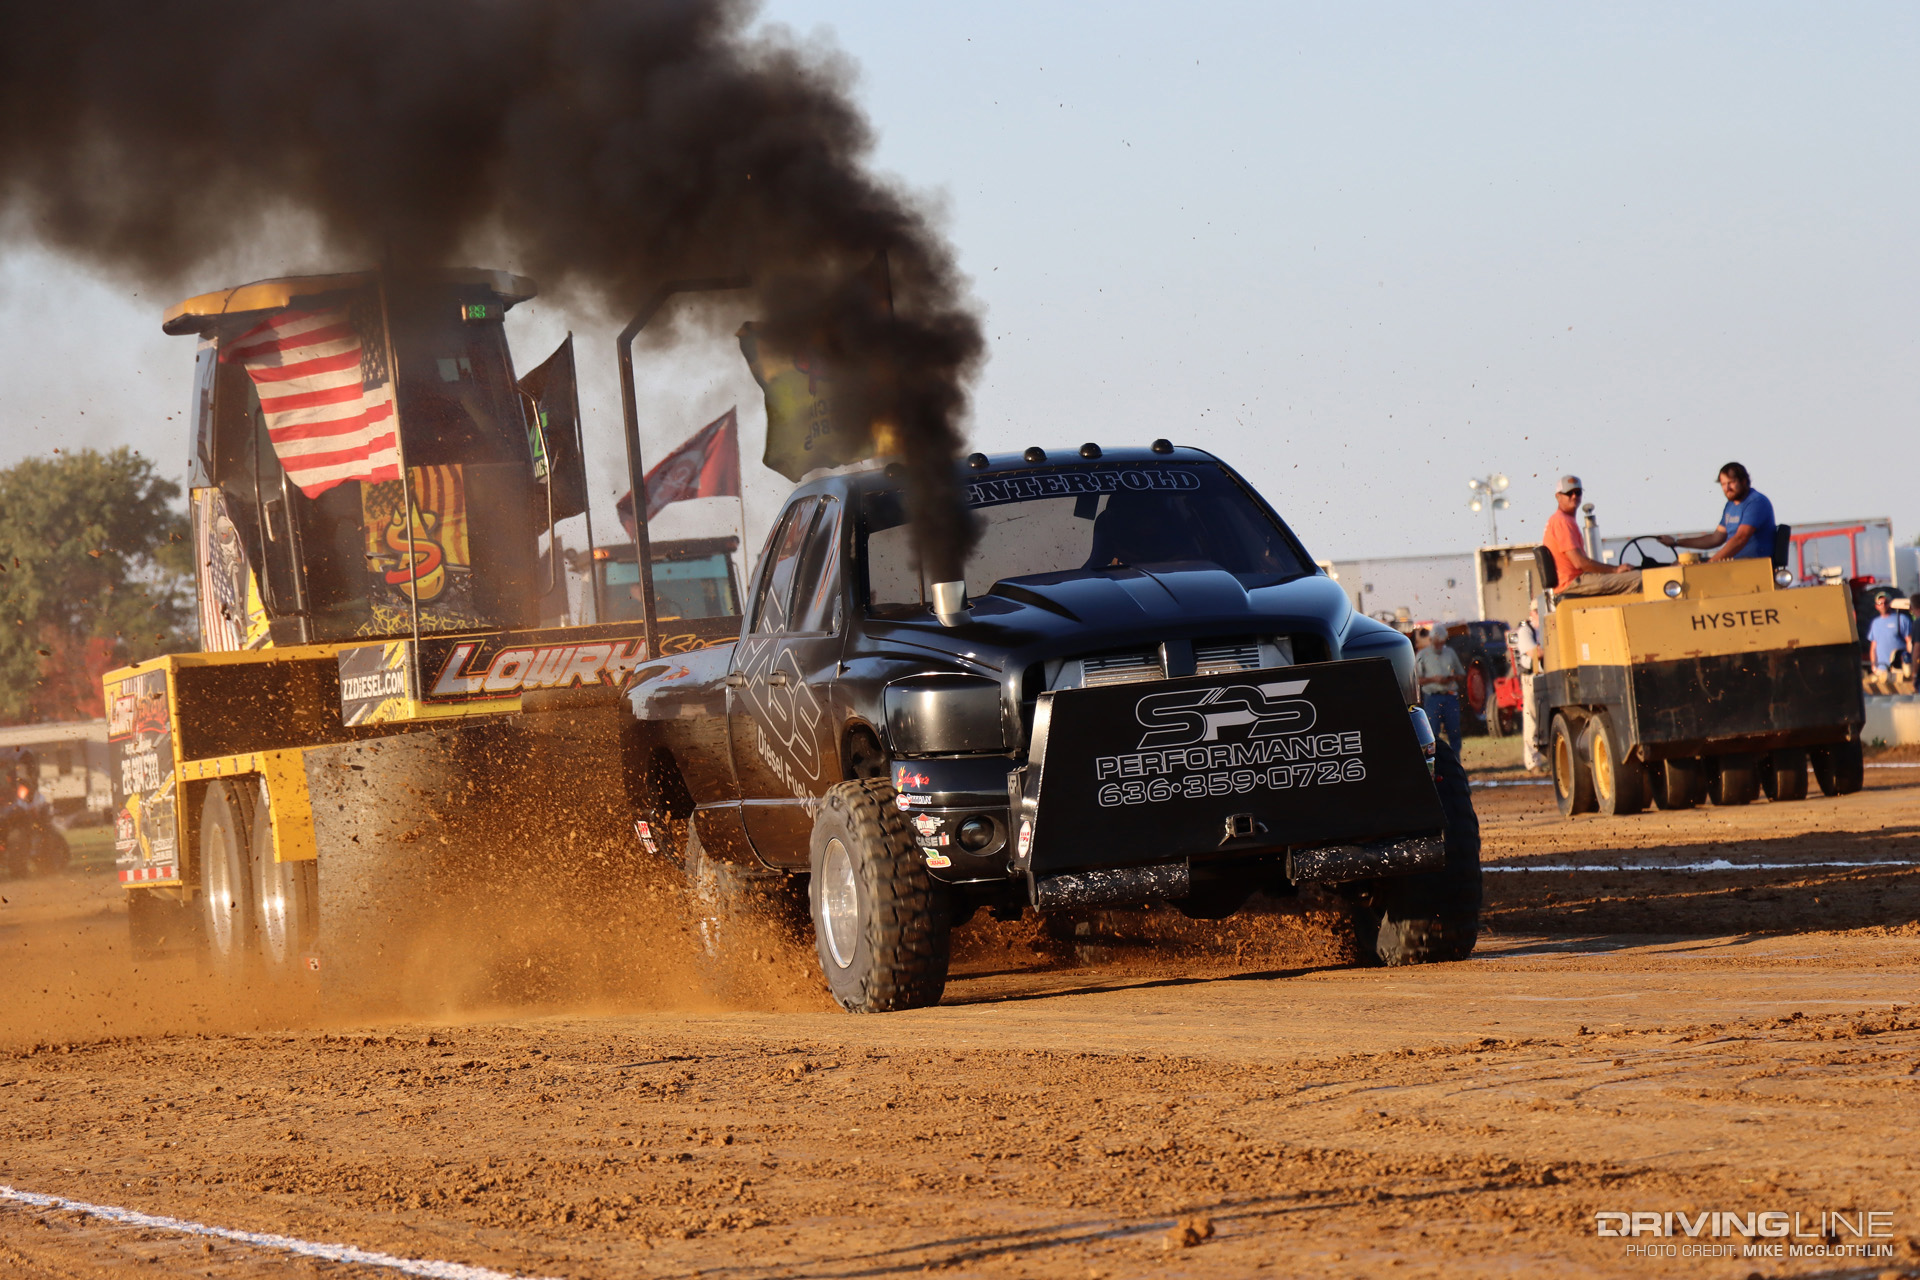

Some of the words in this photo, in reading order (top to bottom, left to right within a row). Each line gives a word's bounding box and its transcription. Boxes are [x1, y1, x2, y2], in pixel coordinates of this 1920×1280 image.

[964, 469, 1200, 504] ENTERFOLD
[1691, 608, 1780, 631] HYSTER
[1135, 679, 1317, 750] SPS
[758, 724, 785, 783] Diesel
[785, 761, 807, 809] Fuel
[1096, 730, 1363, 780] PERFORMANCE
[915, 834, 939, 847] CASE
